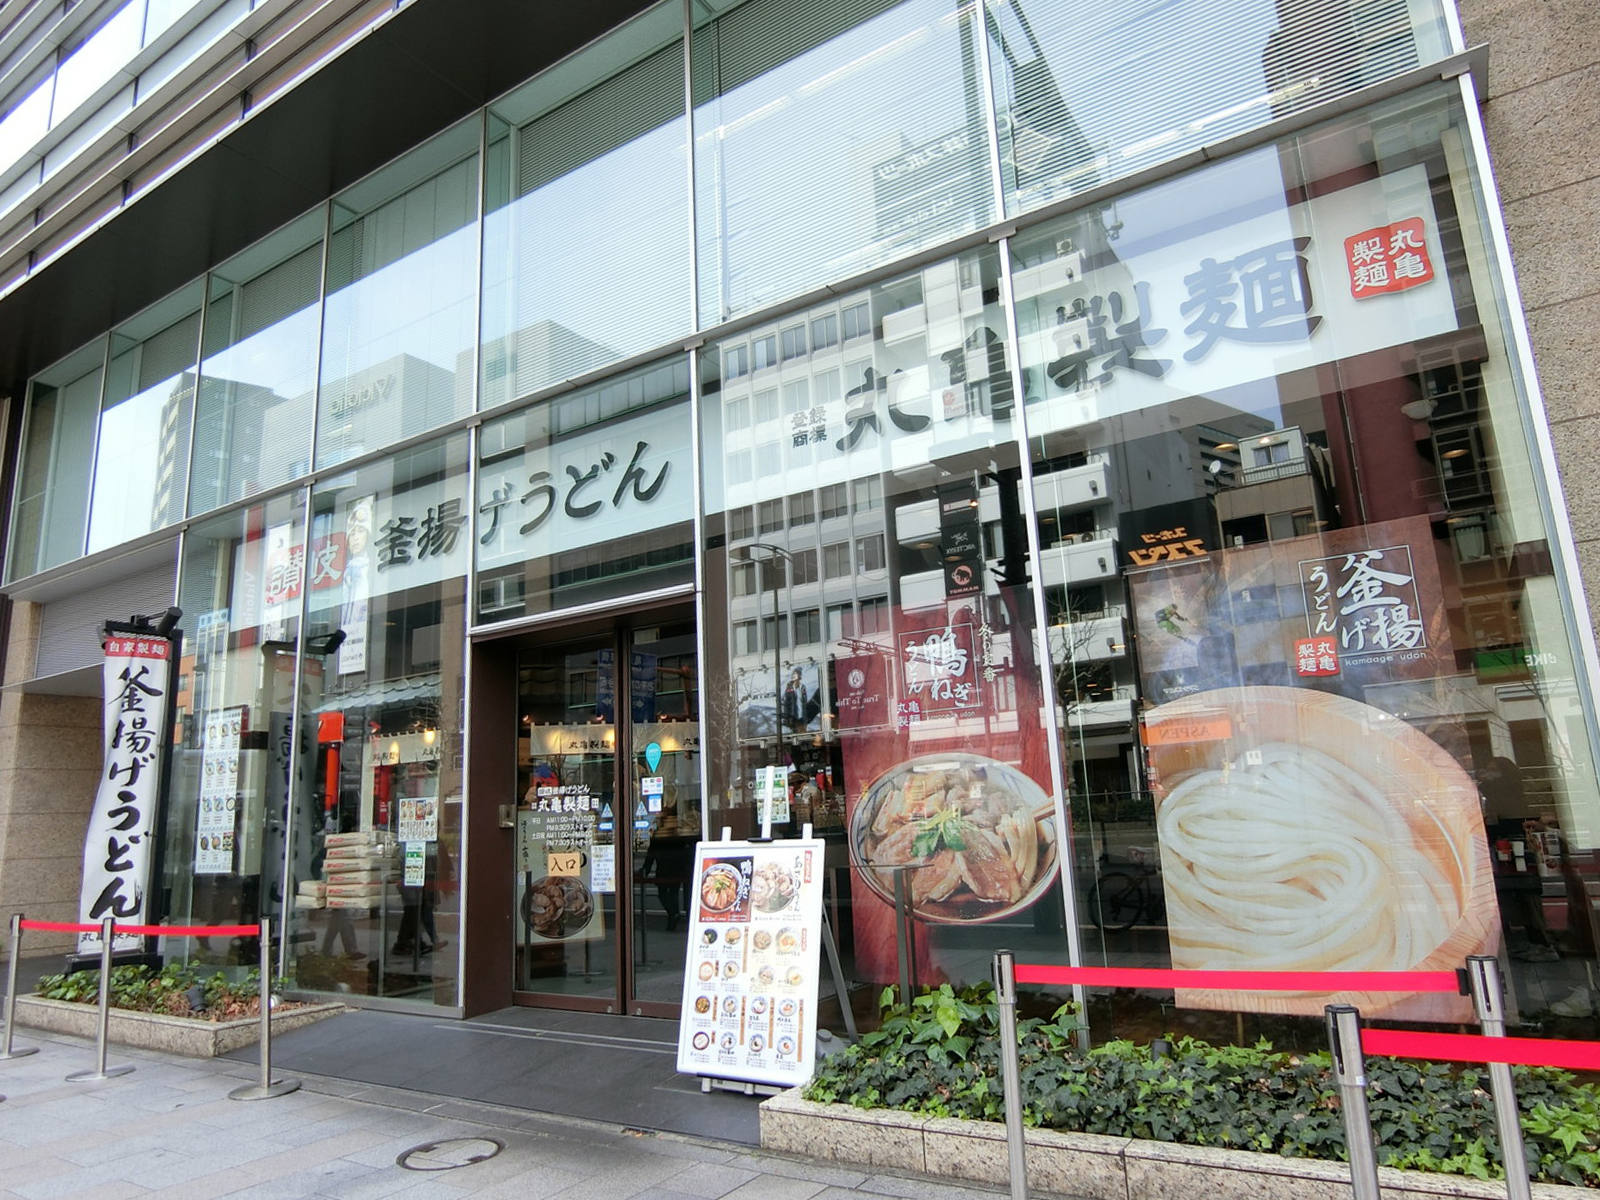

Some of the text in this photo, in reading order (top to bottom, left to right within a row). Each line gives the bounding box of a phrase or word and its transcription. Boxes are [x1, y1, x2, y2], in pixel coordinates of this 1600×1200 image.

[1351, 237, 1390, 292] 製麺
[1387, 229, 1427, 280] 丸亀
[835, 236, 1324, 452] 丸亀製麺
[791, 405, 827, 430] 登録
[792, 424, 828, 449] 商標
[375, 440, 671, 574] 釜揚げうどん
[1309, 566, 1338, 635] うどん
[109, 641, 165, 656] 自家製麺
[1297, 642, 1317, 673] 製麺
[1316, 641, 1336, 671] 丸亀
[1400, 651, 1427, 660] udon
[88, 665, 164, 919] 釜揚げうどん
[538, 796, 590, 813] 丸亀製麺
[551, 857, 577, 872] 入口
